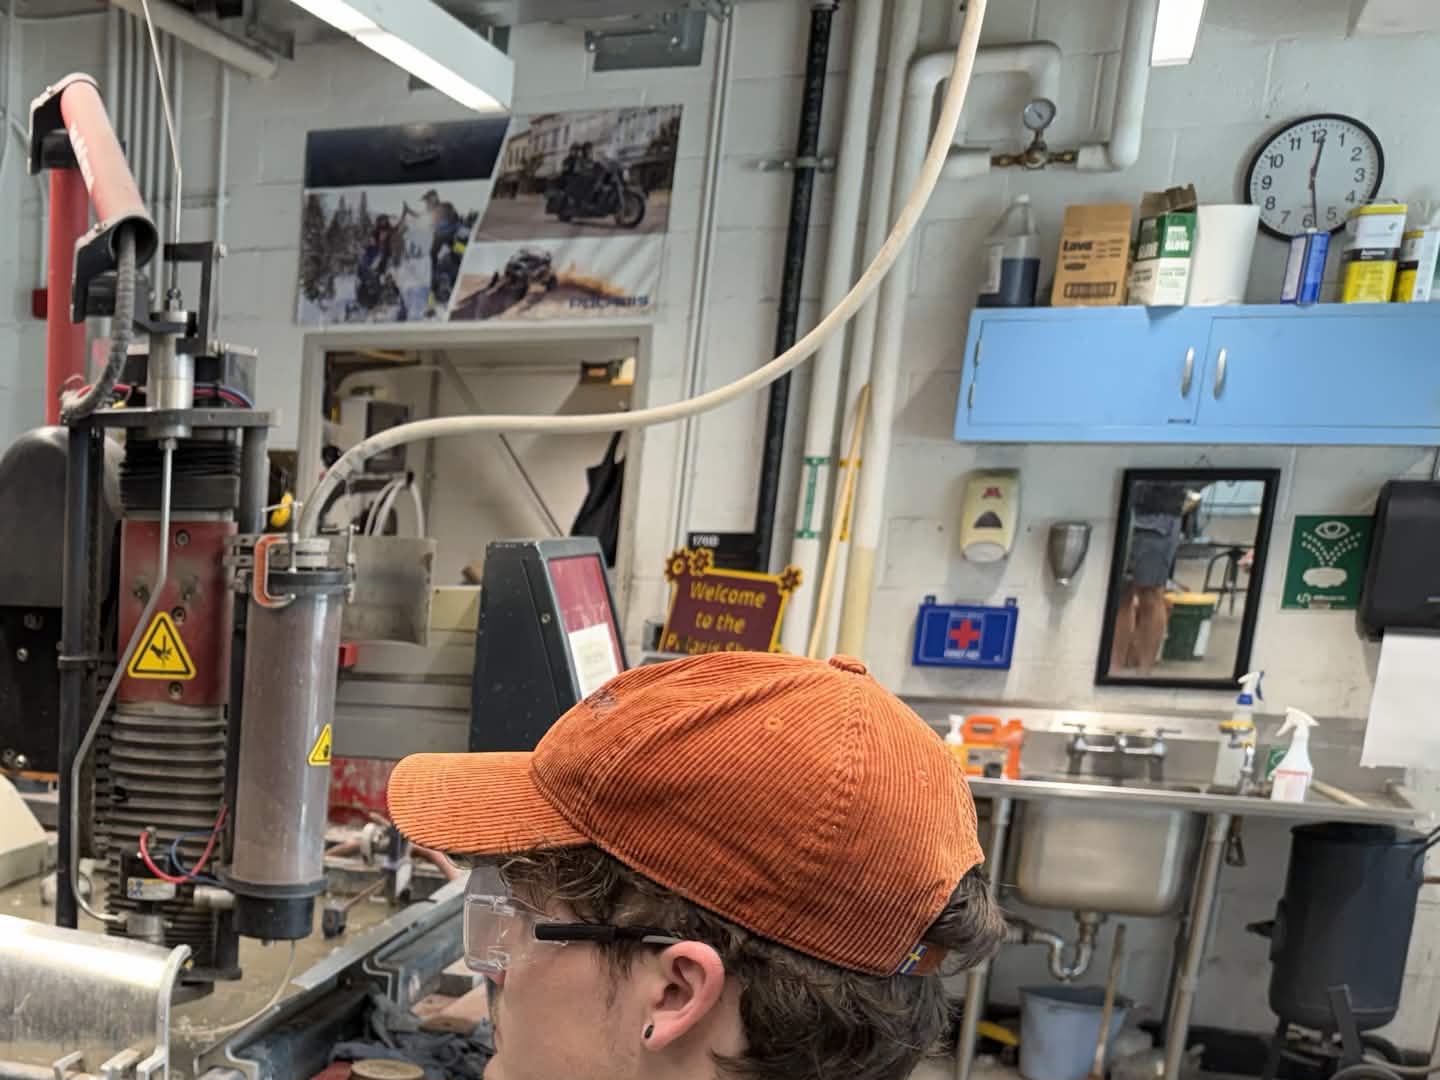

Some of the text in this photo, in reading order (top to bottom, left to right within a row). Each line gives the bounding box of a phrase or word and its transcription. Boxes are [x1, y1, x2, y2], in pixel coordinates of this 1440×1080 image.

[1311, 128, 1328, 143] 12
[1338, 132, 1345, 147] 1
[1289, 137, 1302, 151] 11
[1269, 153, 1284, 168] 10
[1351, 147, 1362, 161] 2
[1354, 167, 1365, 182] 3
[1262, 175, 1272, 190] 9
[1265, 196, 1276, 210] 8
[1345, 189, 1355, 203] 4
[1281, 209, 1291, 224] 7
[1302, 213, 1313, 228] 6
[1327, 206, 1337, 221] 5
[690, 581, 766, 609] Welcome
[695, 611, 746, 634] to the
